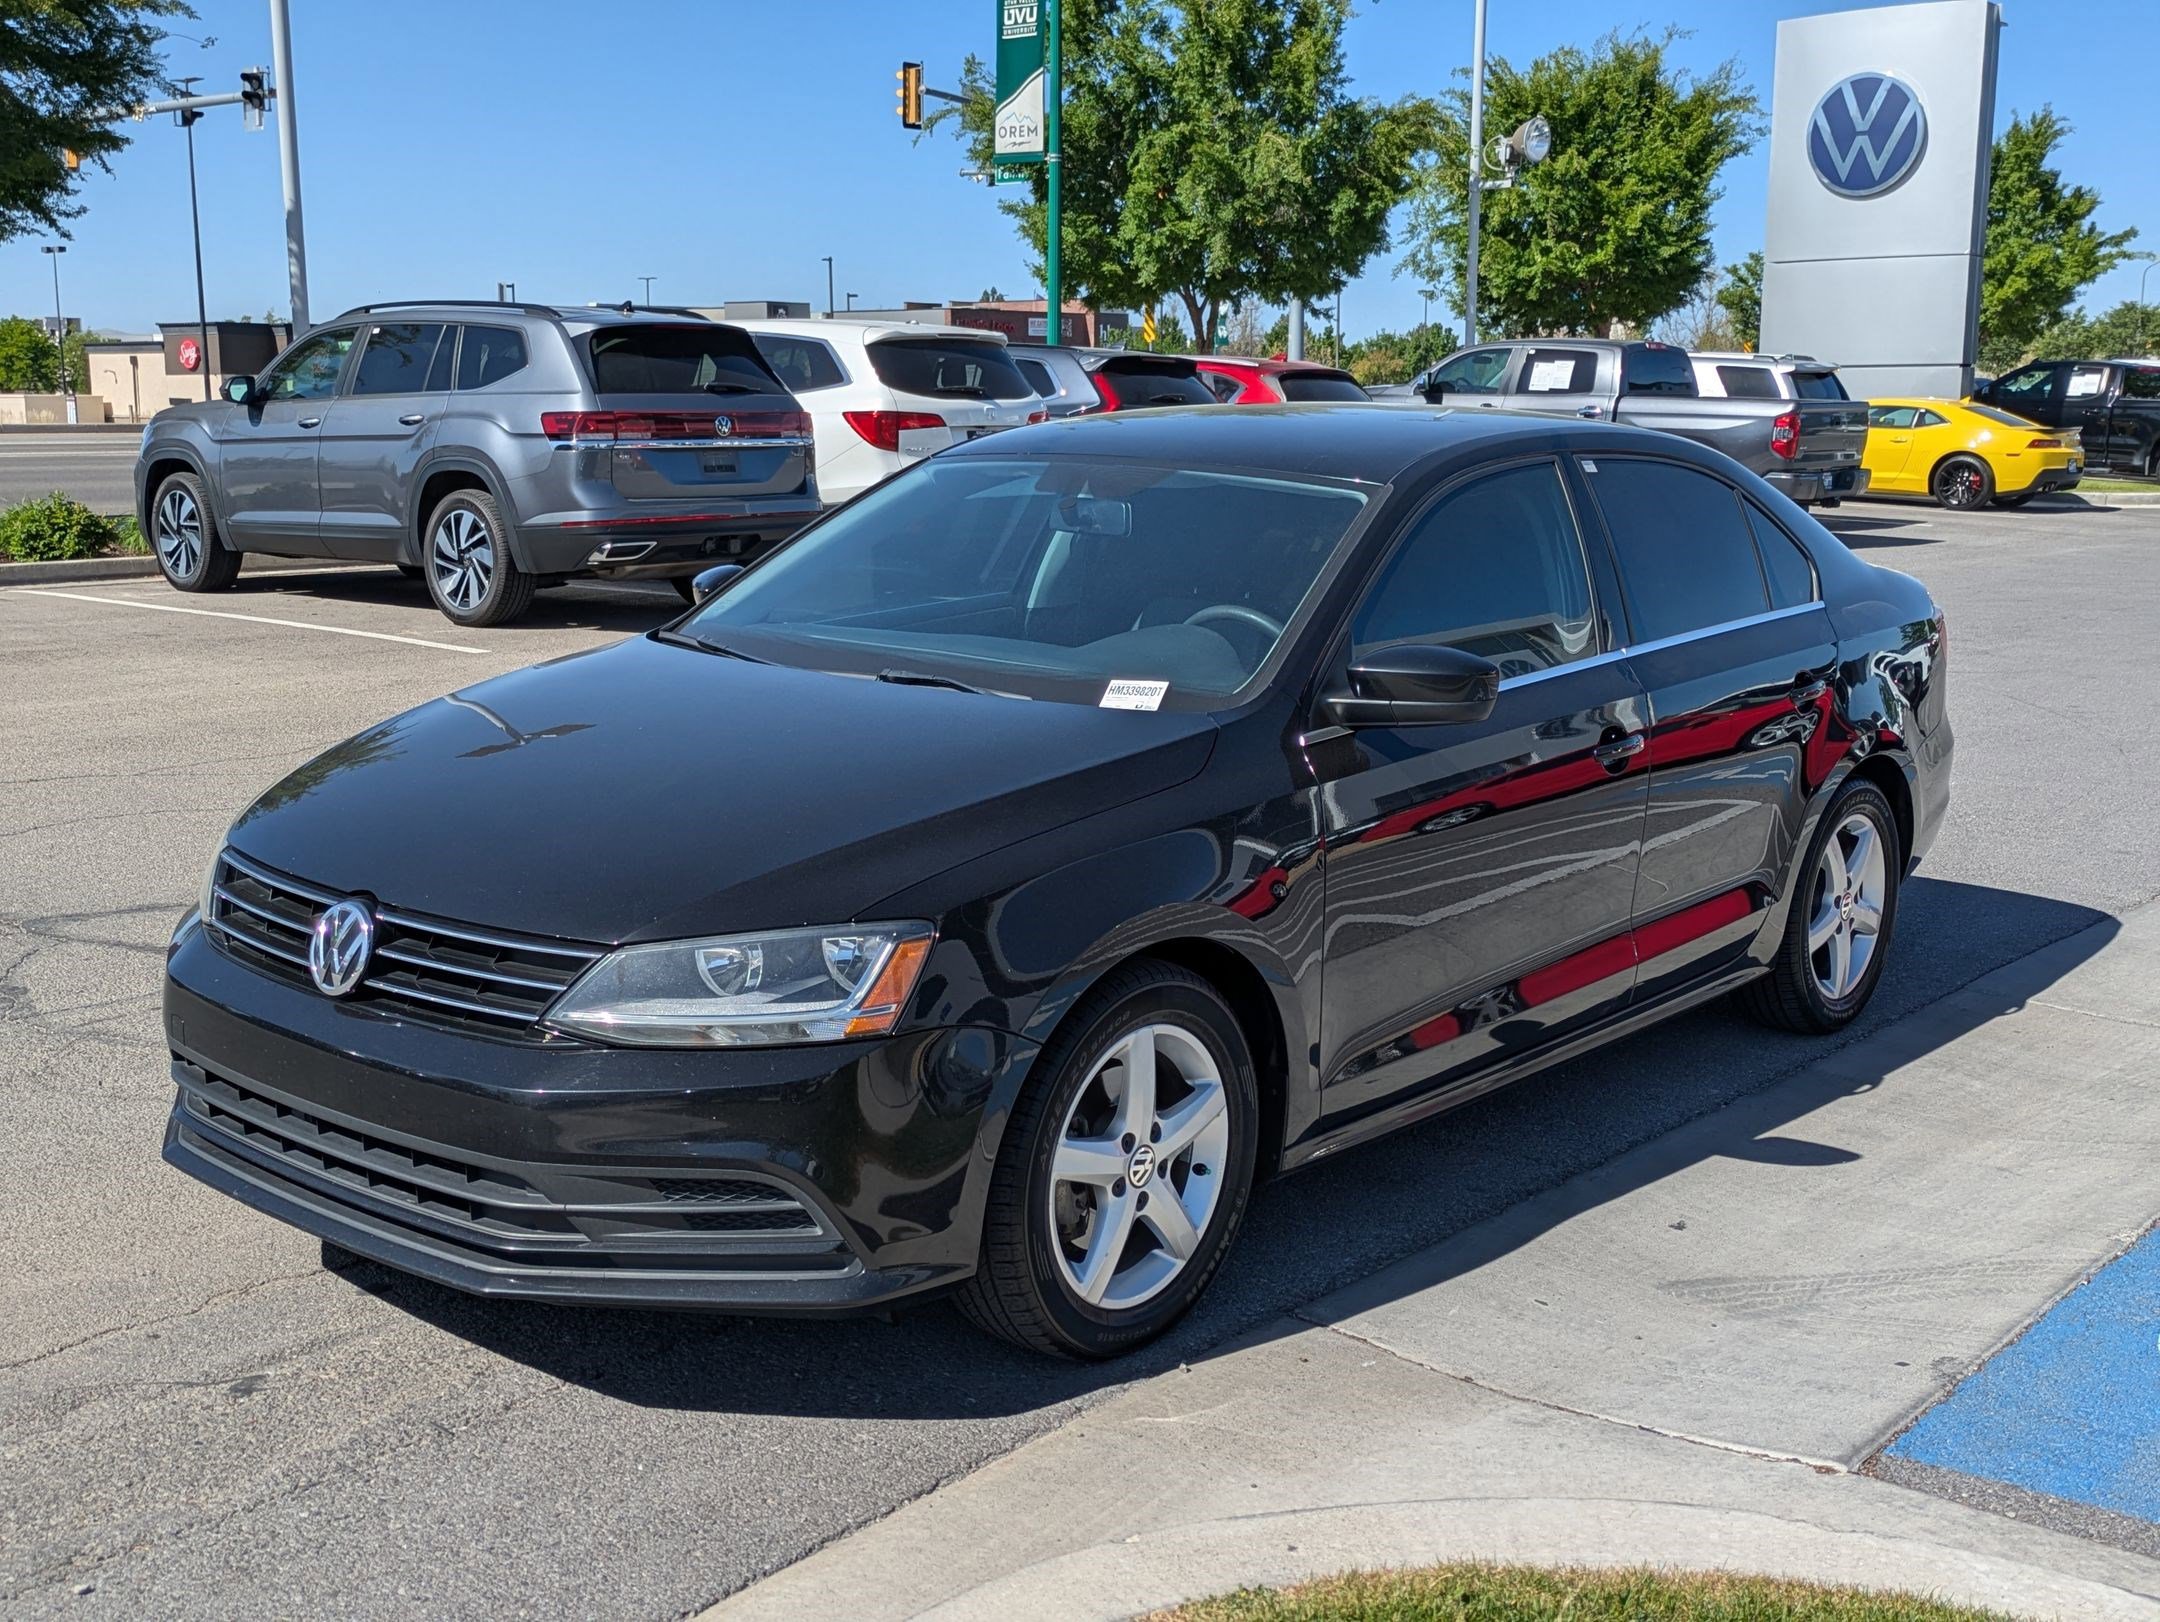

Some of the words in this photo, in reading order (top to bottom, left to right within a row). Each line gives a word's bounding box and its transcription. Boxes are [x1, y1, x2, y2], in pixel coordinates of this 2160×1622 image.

[1003, 6, 1037, 25] UVU
[1003, 26, 1036, 36] UNIVERSITY
[998, 124, 1038, 139] OREM
[1810, 74, 1922, 190] VW
